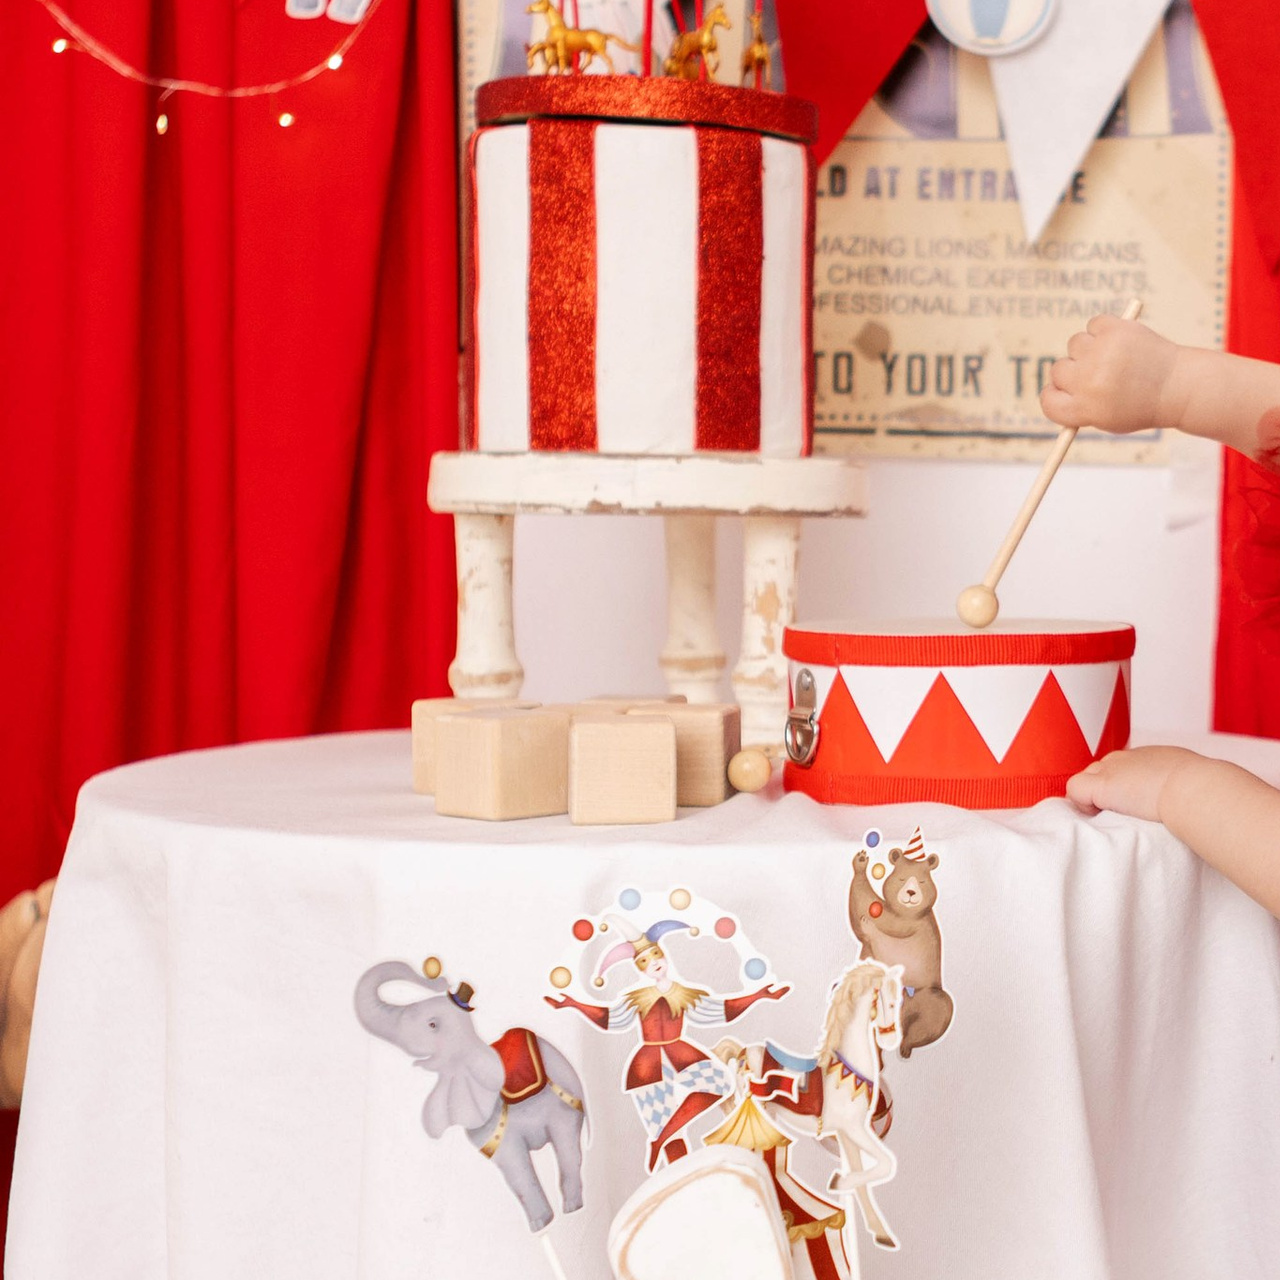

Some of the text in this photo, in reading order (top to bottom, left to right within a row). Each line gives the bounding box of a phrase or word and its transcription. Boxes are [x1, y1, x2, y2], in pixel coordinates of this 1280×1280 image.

[864, 166, 901, 200] AT
[917, 167, 1088, 205] ENTRAE
[827, 264, 960, 289] CHEMICAL
[880, 351, 985, 398] YOUR
